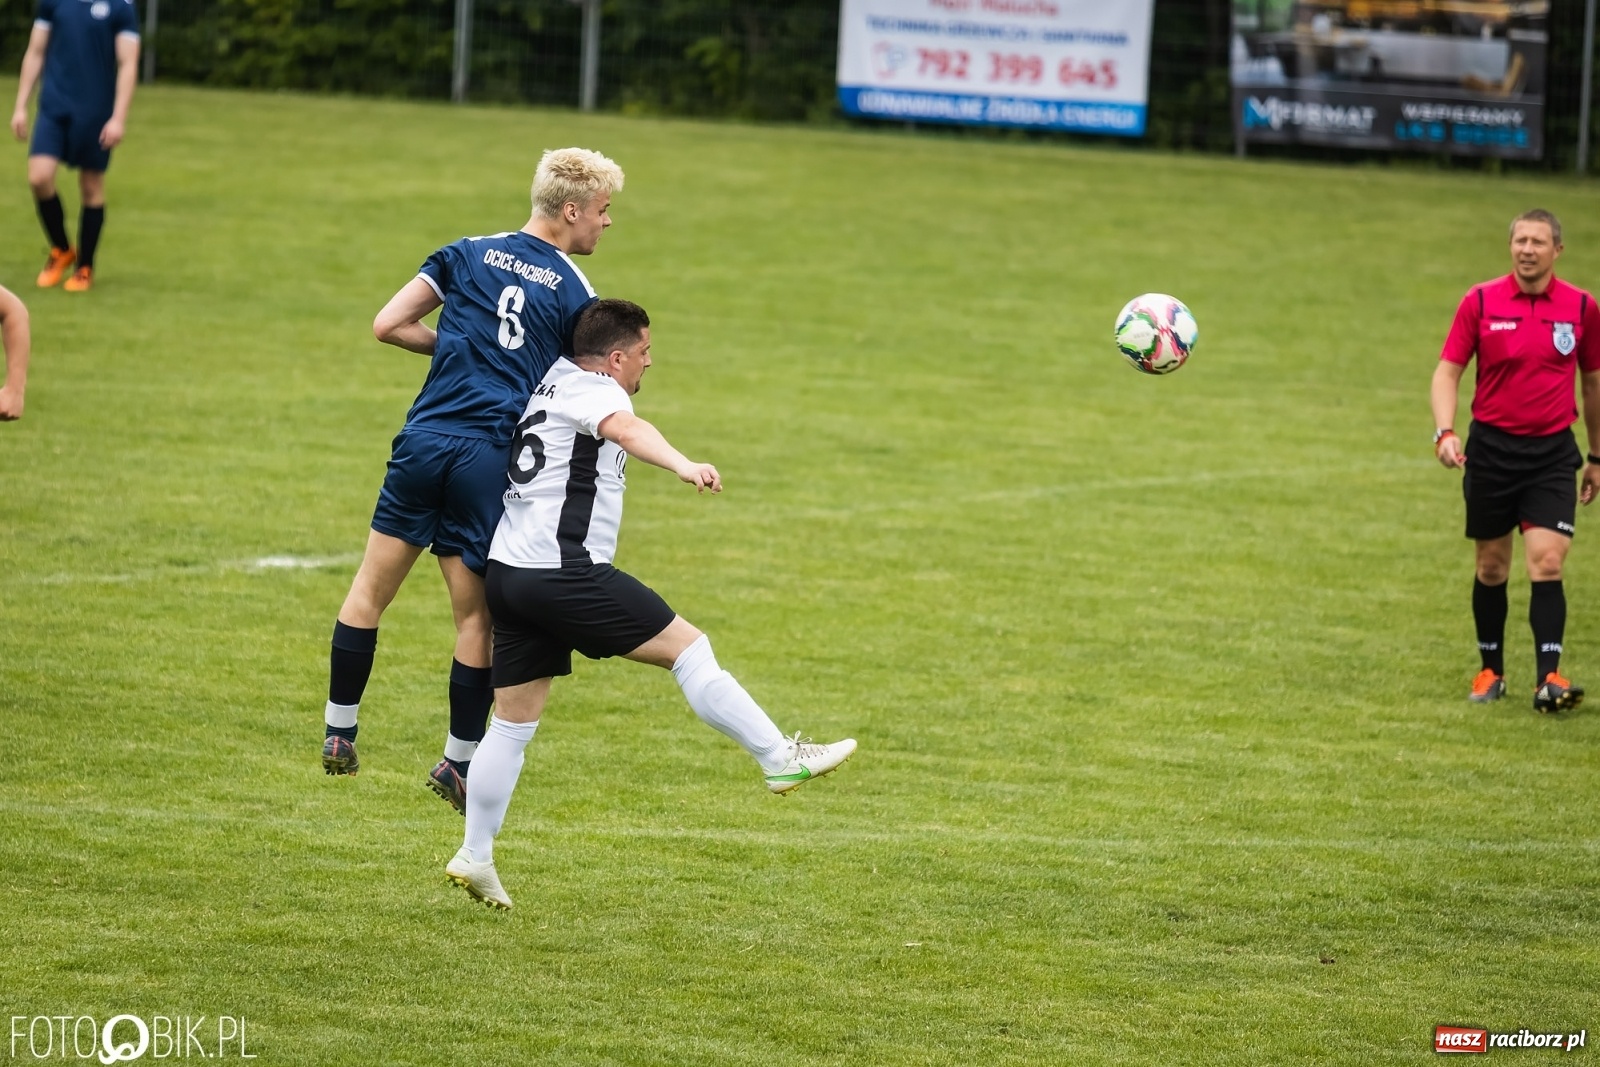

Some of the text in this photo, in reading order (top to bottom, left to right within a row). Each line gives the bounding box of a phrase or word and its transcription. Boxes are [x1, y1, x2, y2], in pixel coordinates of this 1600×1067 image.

[917, 47, 1118, 89] 792 399 645
[483, 248, 562, 290] OCICE RACIBÓRZ
[496, 285, 526, 350] 6
[508, 409, 548, 485] 6
